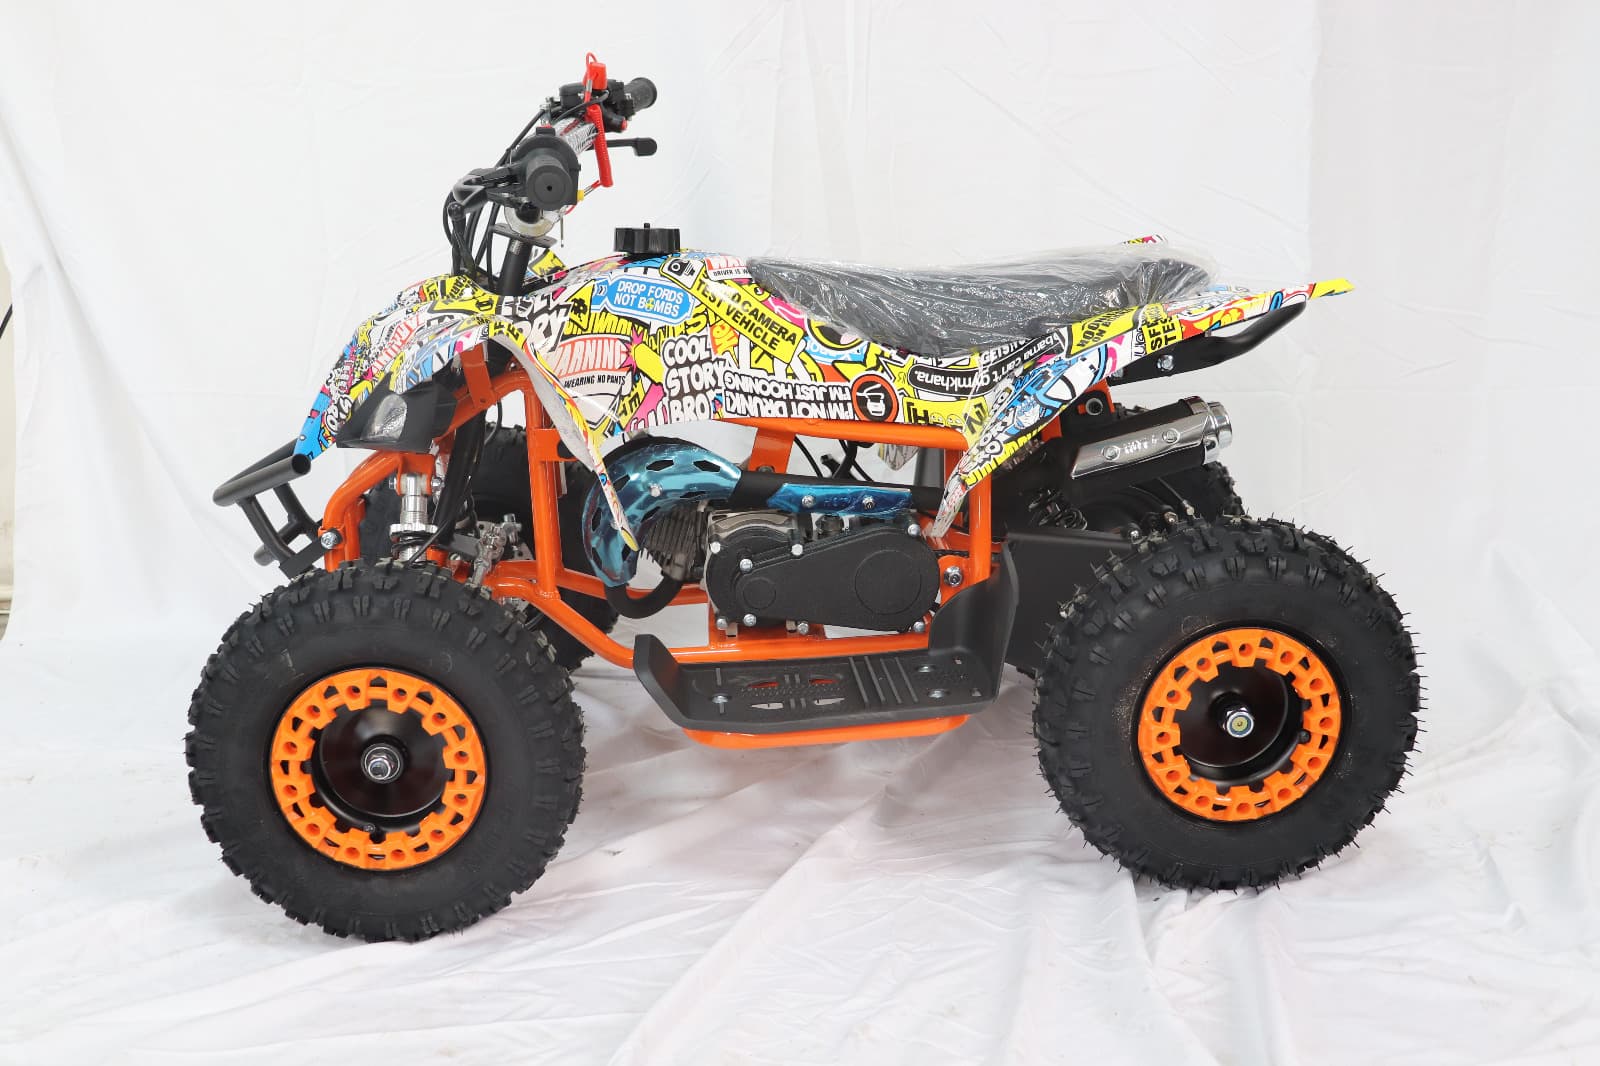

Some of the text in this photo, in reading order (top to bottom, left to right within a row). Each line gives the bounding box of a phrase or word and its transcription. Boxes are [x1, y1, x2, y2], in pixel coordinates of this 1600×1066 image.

[614, 292, 636, 306] NOT
[617, 280, 647, 297] DROP
[649, 286, 684, 304] FORDS
[726, 304, 780, 350] VEHICLE
[741, 300, 797, 345] CAMERA
[663, 335, 712, 366] COOL
[564, 374, 626, 388] WEARING NO PANTS
[664, 359, 725, 397] STORY
[992, 357, 1021, 382] can't
[724, 370, 852, 401] I'M JUST HOONING
[669, 393, 711, 424] BRO
[725, 391, 788, 418] DRUNK!
[790, 401, 826, 418] NOT
